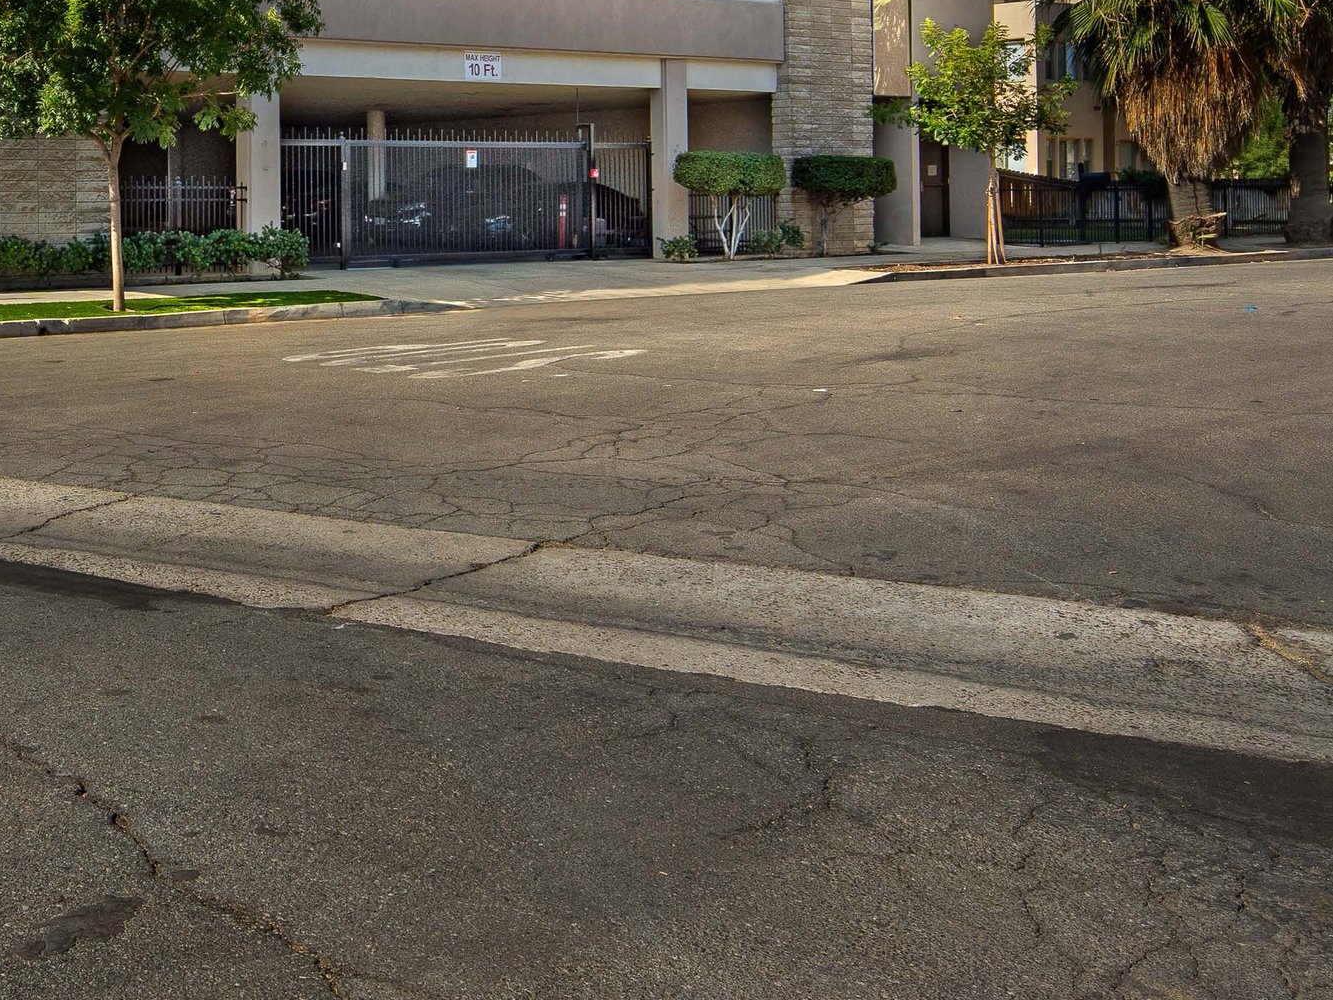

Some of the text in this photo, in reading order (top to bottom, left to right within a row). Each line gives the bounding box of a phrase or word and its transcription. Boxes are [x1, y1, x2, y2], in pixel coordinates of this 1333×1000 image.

[465, 53, 479, 61] MAX
[468, 63, 499, 77] 10 Ft.
